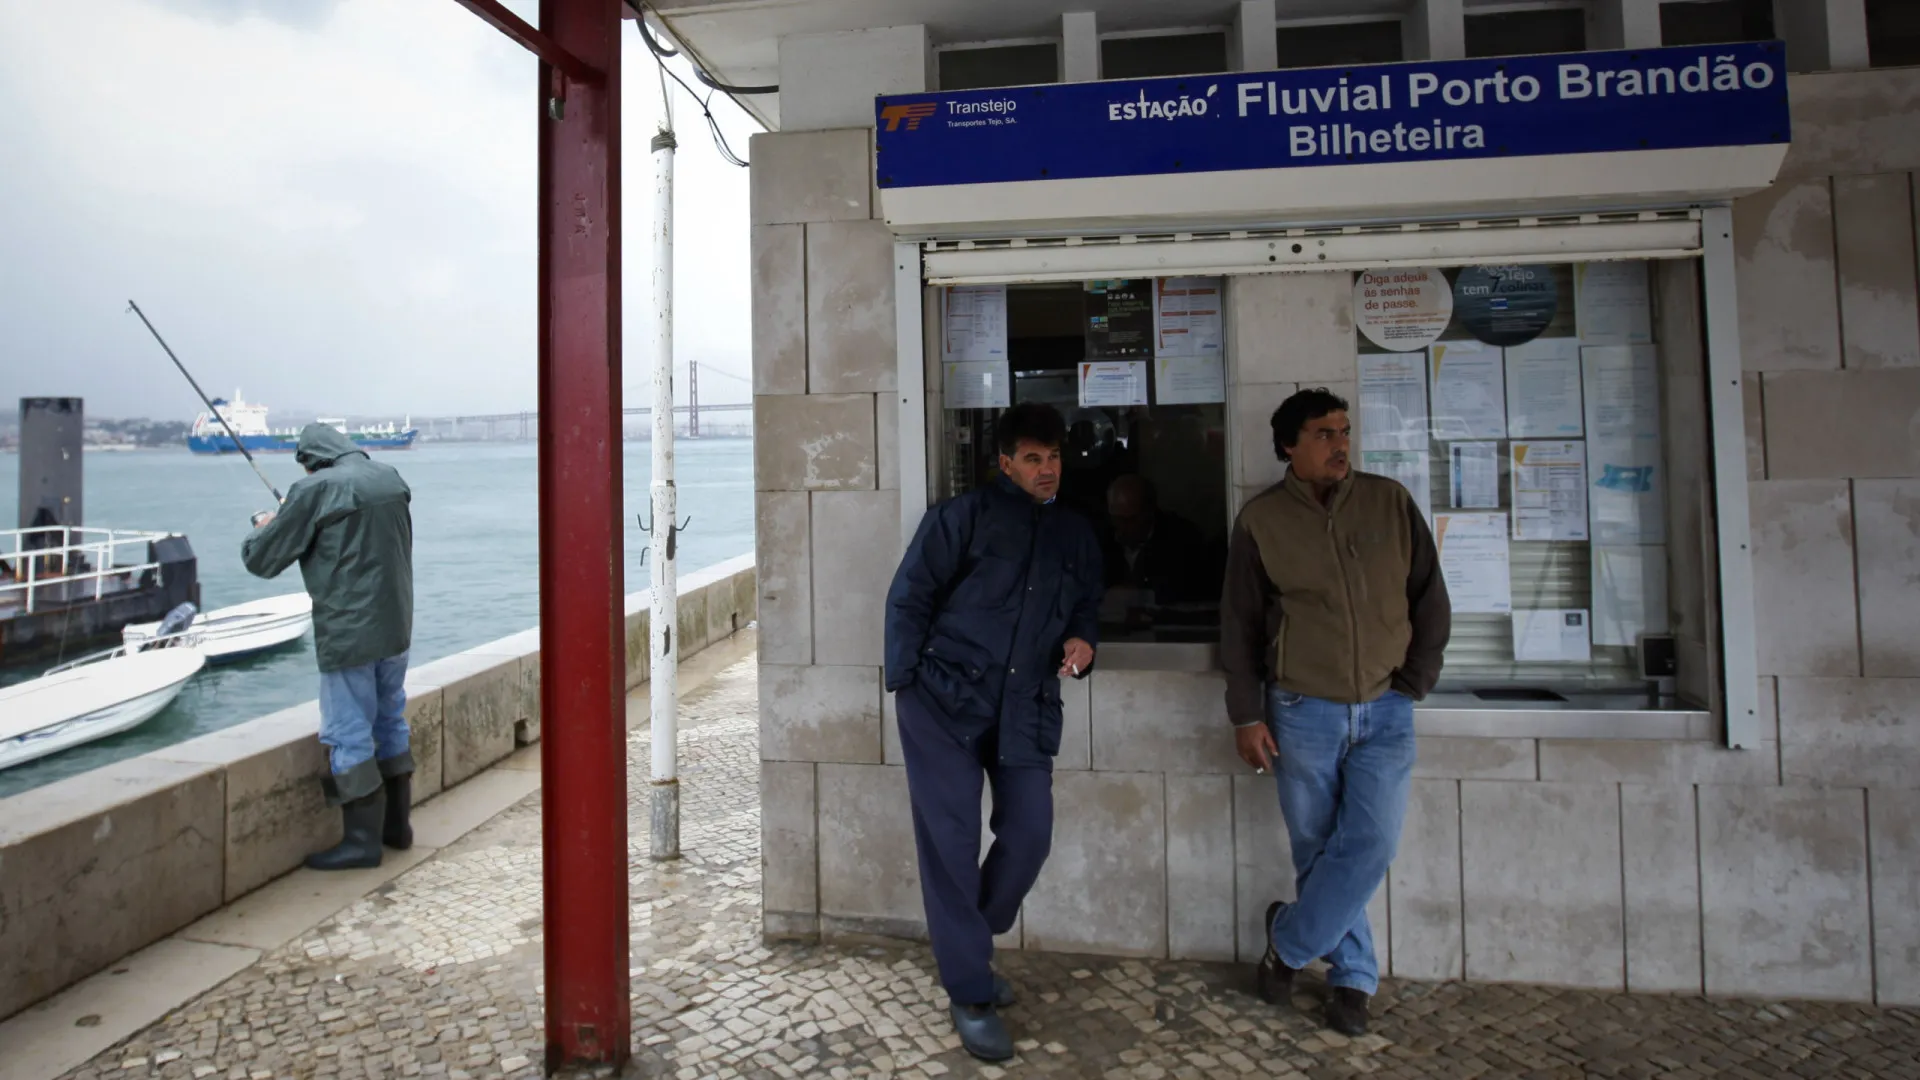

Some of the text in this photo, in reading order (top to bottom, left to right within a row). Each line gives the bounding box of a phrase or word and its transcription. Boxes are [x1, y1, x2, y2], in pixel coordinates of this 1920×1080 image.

[1109, 54, 1775, 121] ESTAÇÃO Fluvial Porto Brandão
[946, 98, 1017, 114] Transtejo
[947, 119, 987, 128] Transportes
[1289, 119, 1486, 157] Bilheteira
[1364, 272, 1428, 286] Diga adeus
[1508, 269, 1535, 284] Tejo
[1380, 286, 1421, 297] senhas
[1463, 285, 1490, 296] tem
[1364, 300, 1419, 312] de passe.
